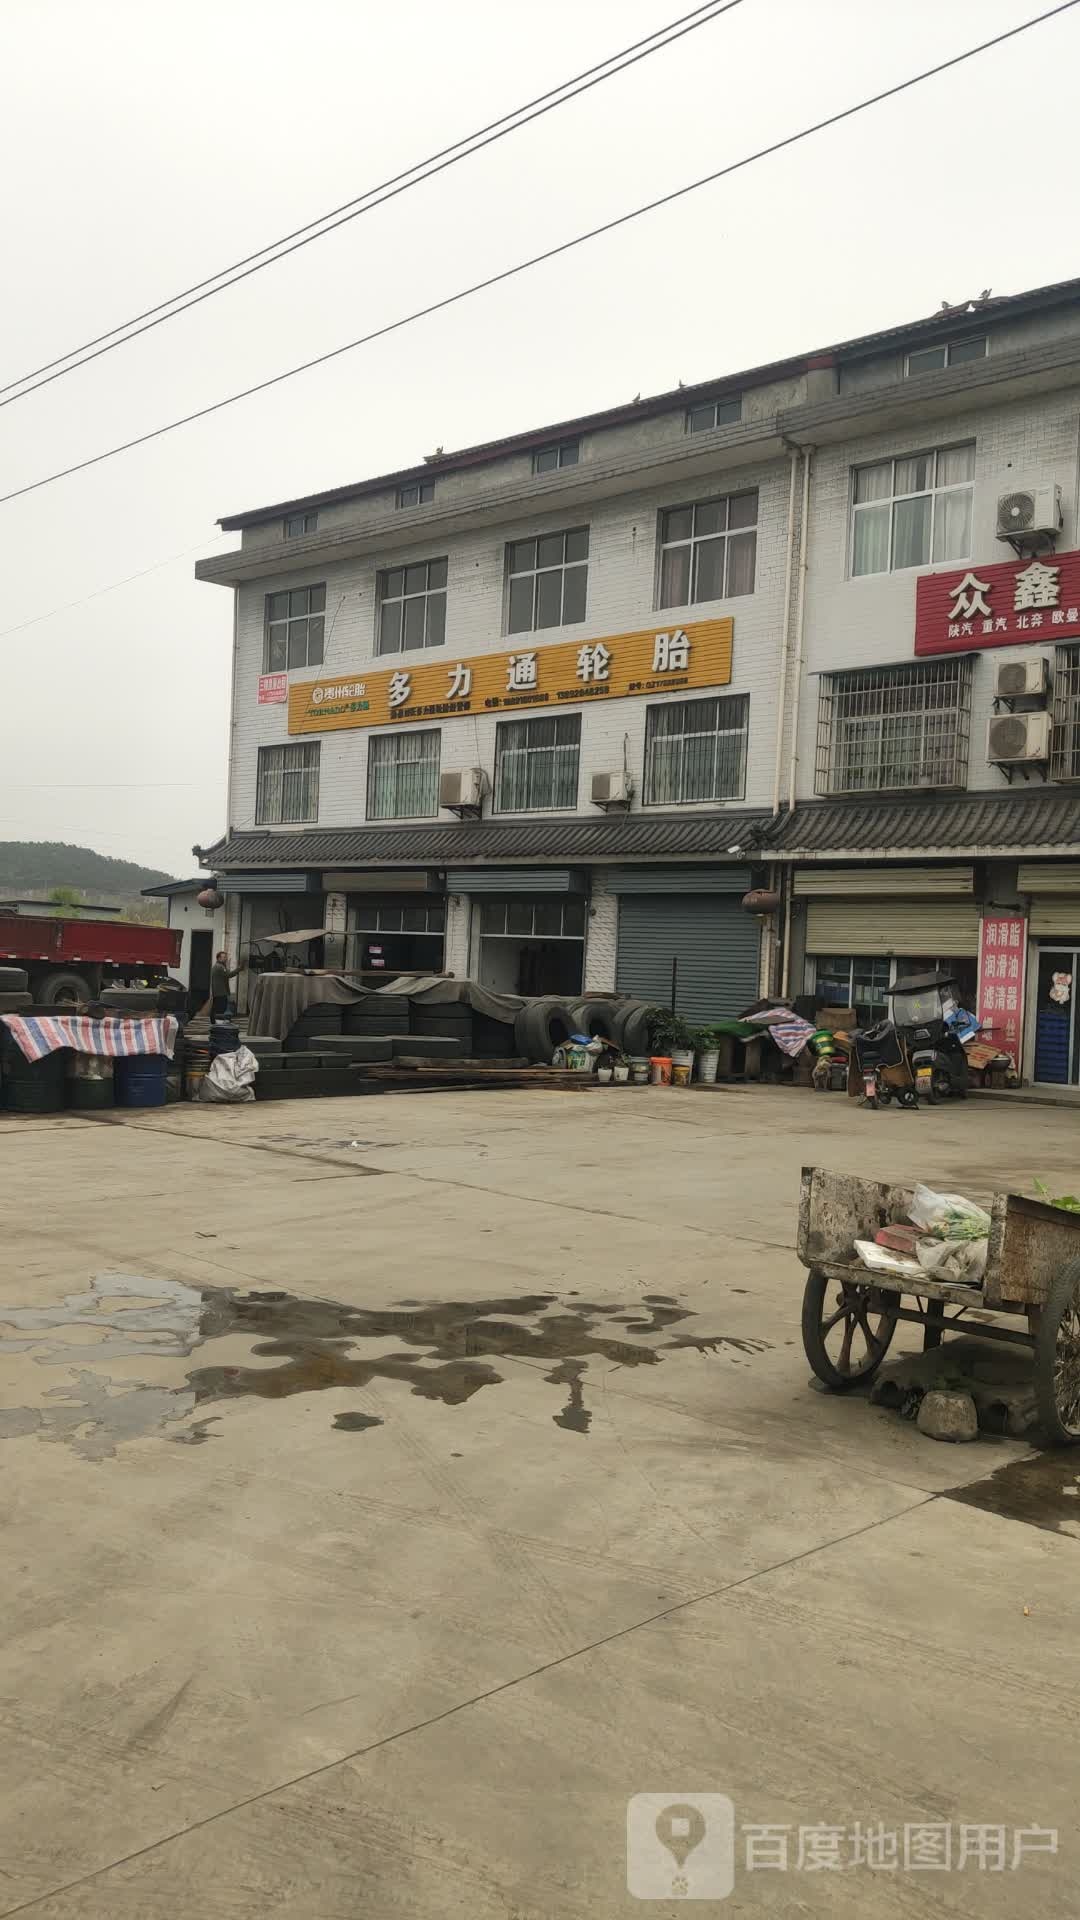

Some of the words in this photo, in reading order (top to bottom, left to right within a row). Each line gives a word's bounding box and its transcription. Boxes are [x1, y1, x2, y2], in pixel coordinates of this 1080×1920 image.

[948, 562, 1061, 620] 众鑫
[948, 622, 973, 638] 陕汽
[982, 617, 1007, 634] 重汽
[1016, 613, 1043, 630] 北奔
[1052, 607, 1079, 624] 欧曼
[388, 629, 692, 708] 多力通轮胎
[986, 922, 1020, 947] 润滑脂
[984, 954, 1018, 979] 润滑油
[983, 986, 1017, 1011] 滤清器
